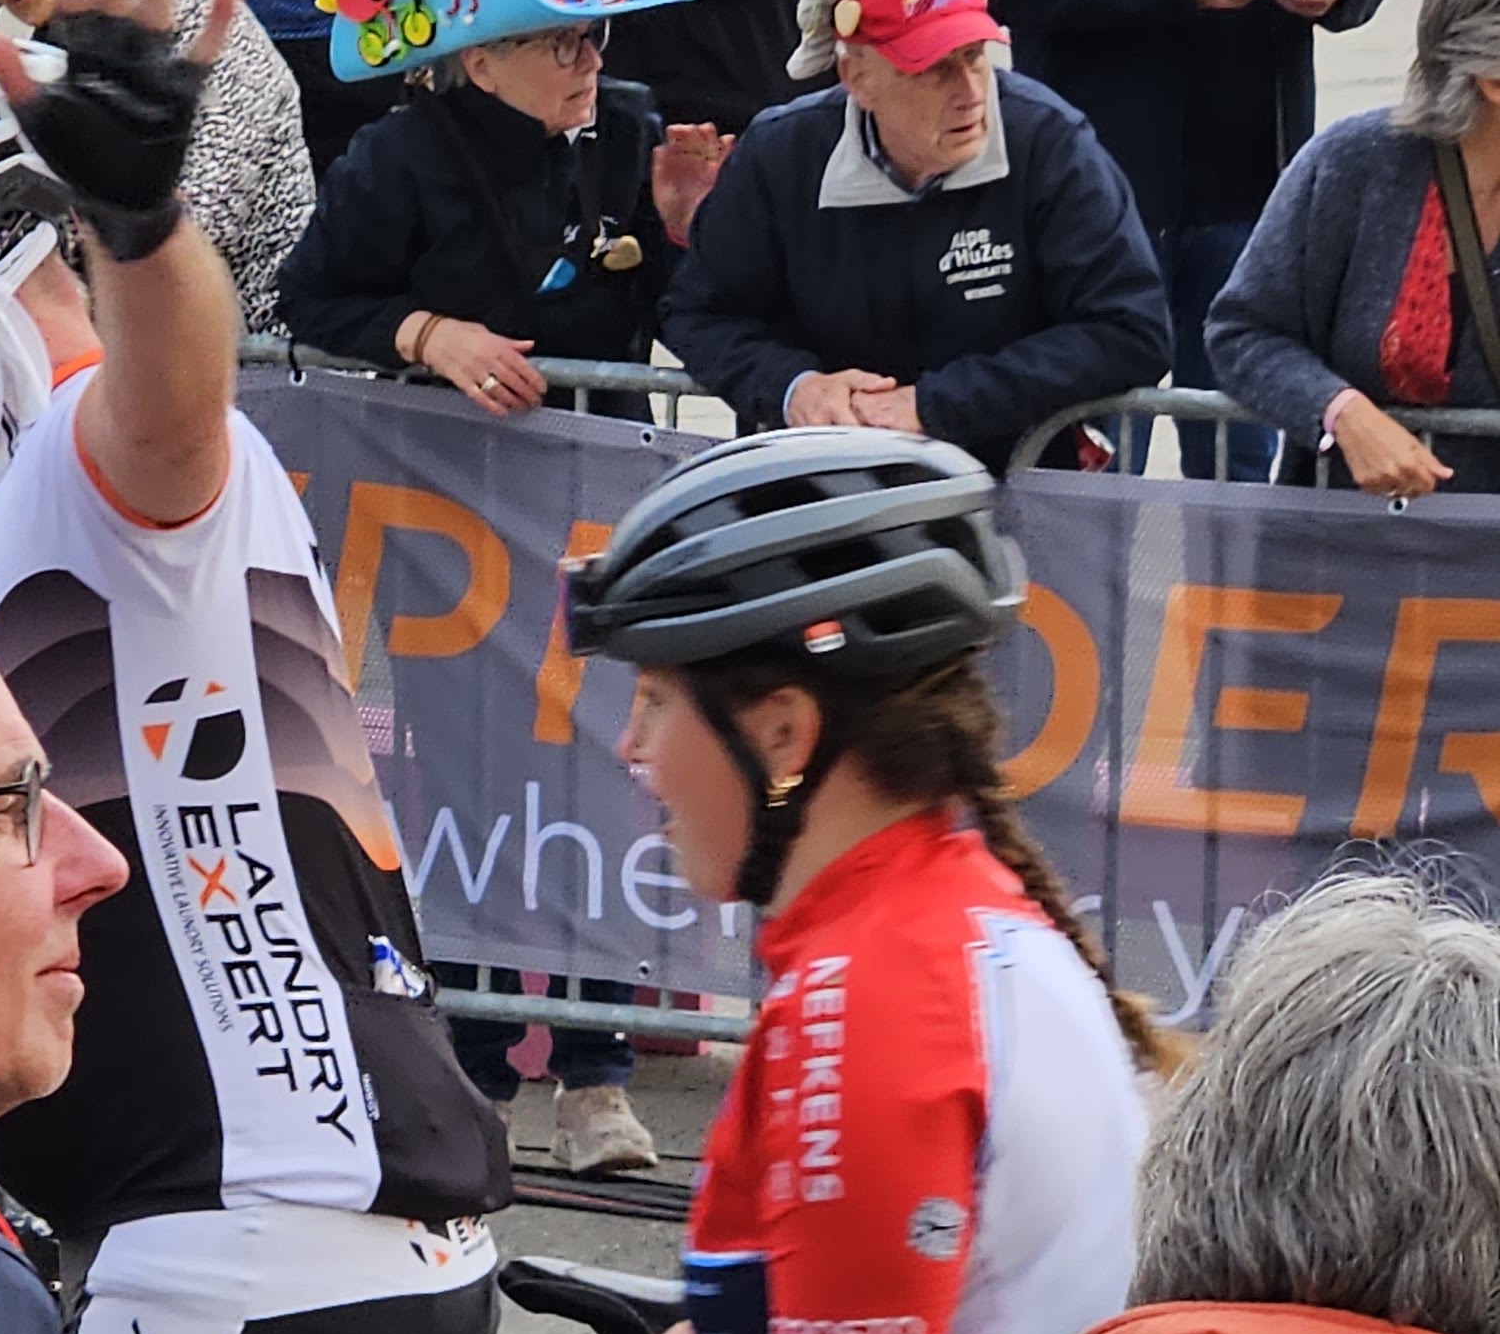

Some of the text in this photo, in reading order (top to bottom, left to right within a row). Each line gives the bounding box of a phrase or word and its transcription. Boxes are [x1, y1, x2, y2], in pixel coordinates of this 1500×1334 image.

[153, 803, 235, 1034] INNOVATIVE LAUNDRY SOLUTIONS
[177, 803, 300, 1094] EXPERT
[224, 801, 357, 1146] LAUNDRY
[800, 955, 852, 1203] NEFKENS
